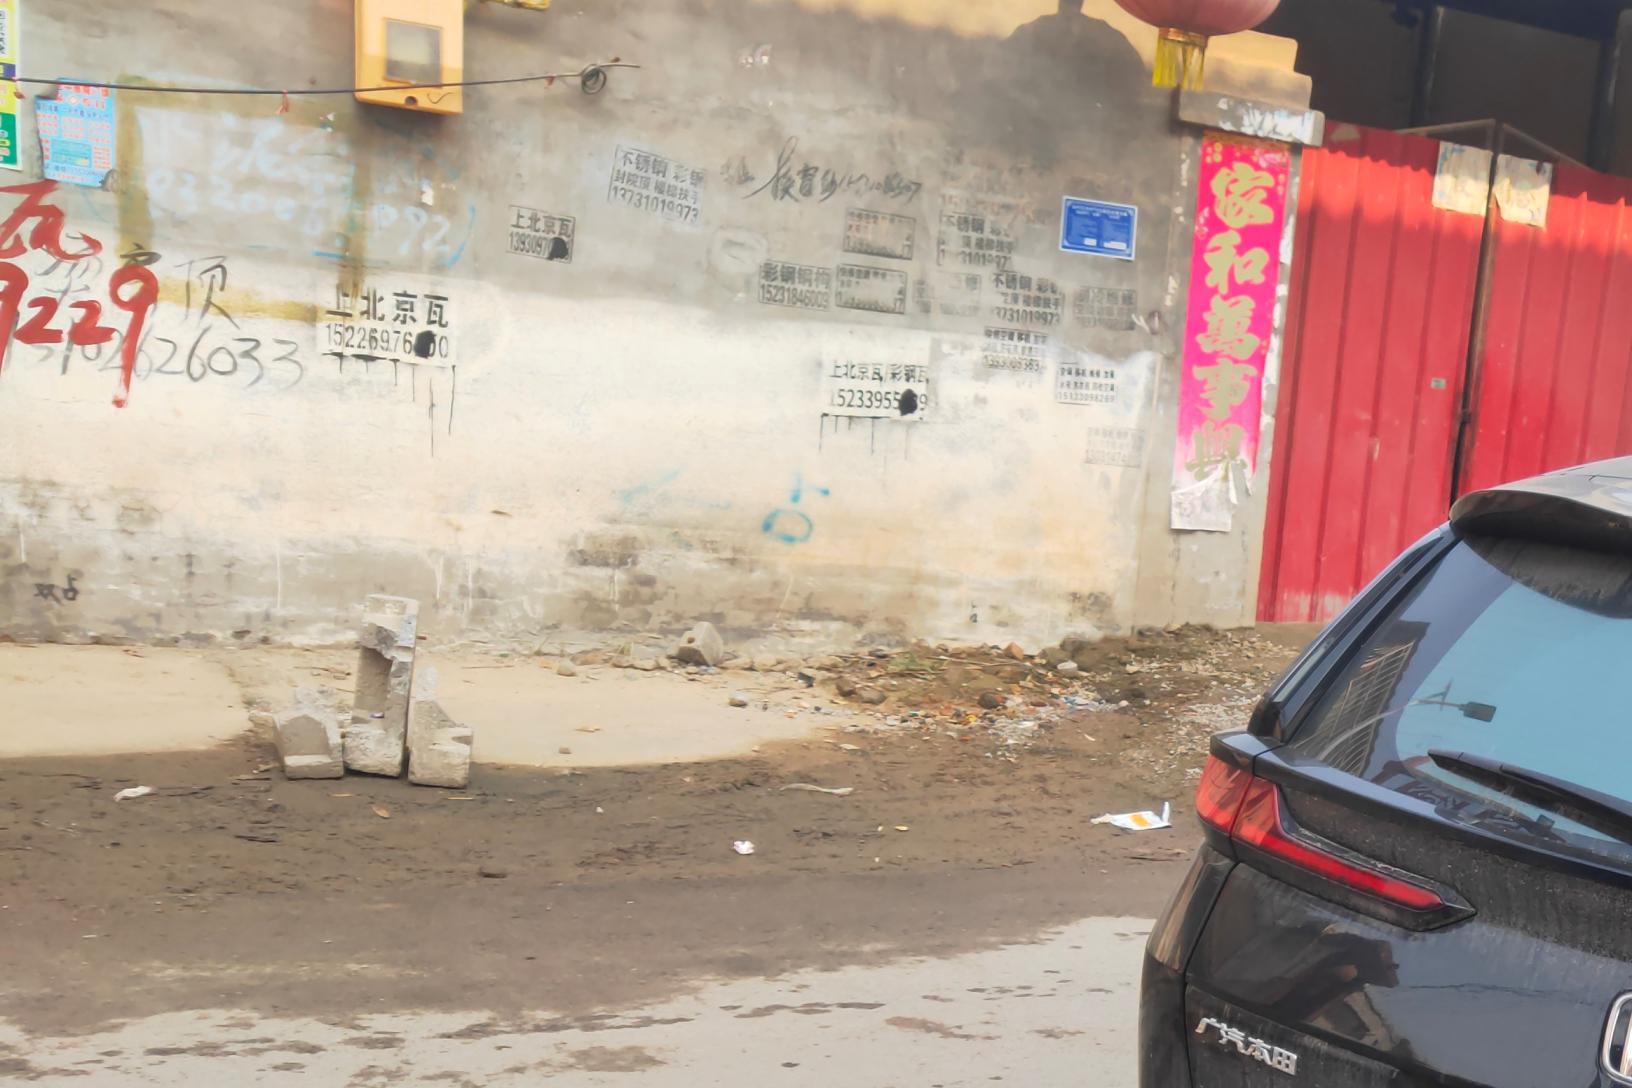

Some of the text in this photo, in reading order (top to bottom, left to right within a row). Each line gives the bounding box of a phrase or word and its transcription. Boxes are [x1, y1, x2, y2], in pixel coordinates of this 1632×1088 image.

[326, 284, 449, 328] 上北京瓦
[1195, 1017, 1298, 1076] 广汽本田
